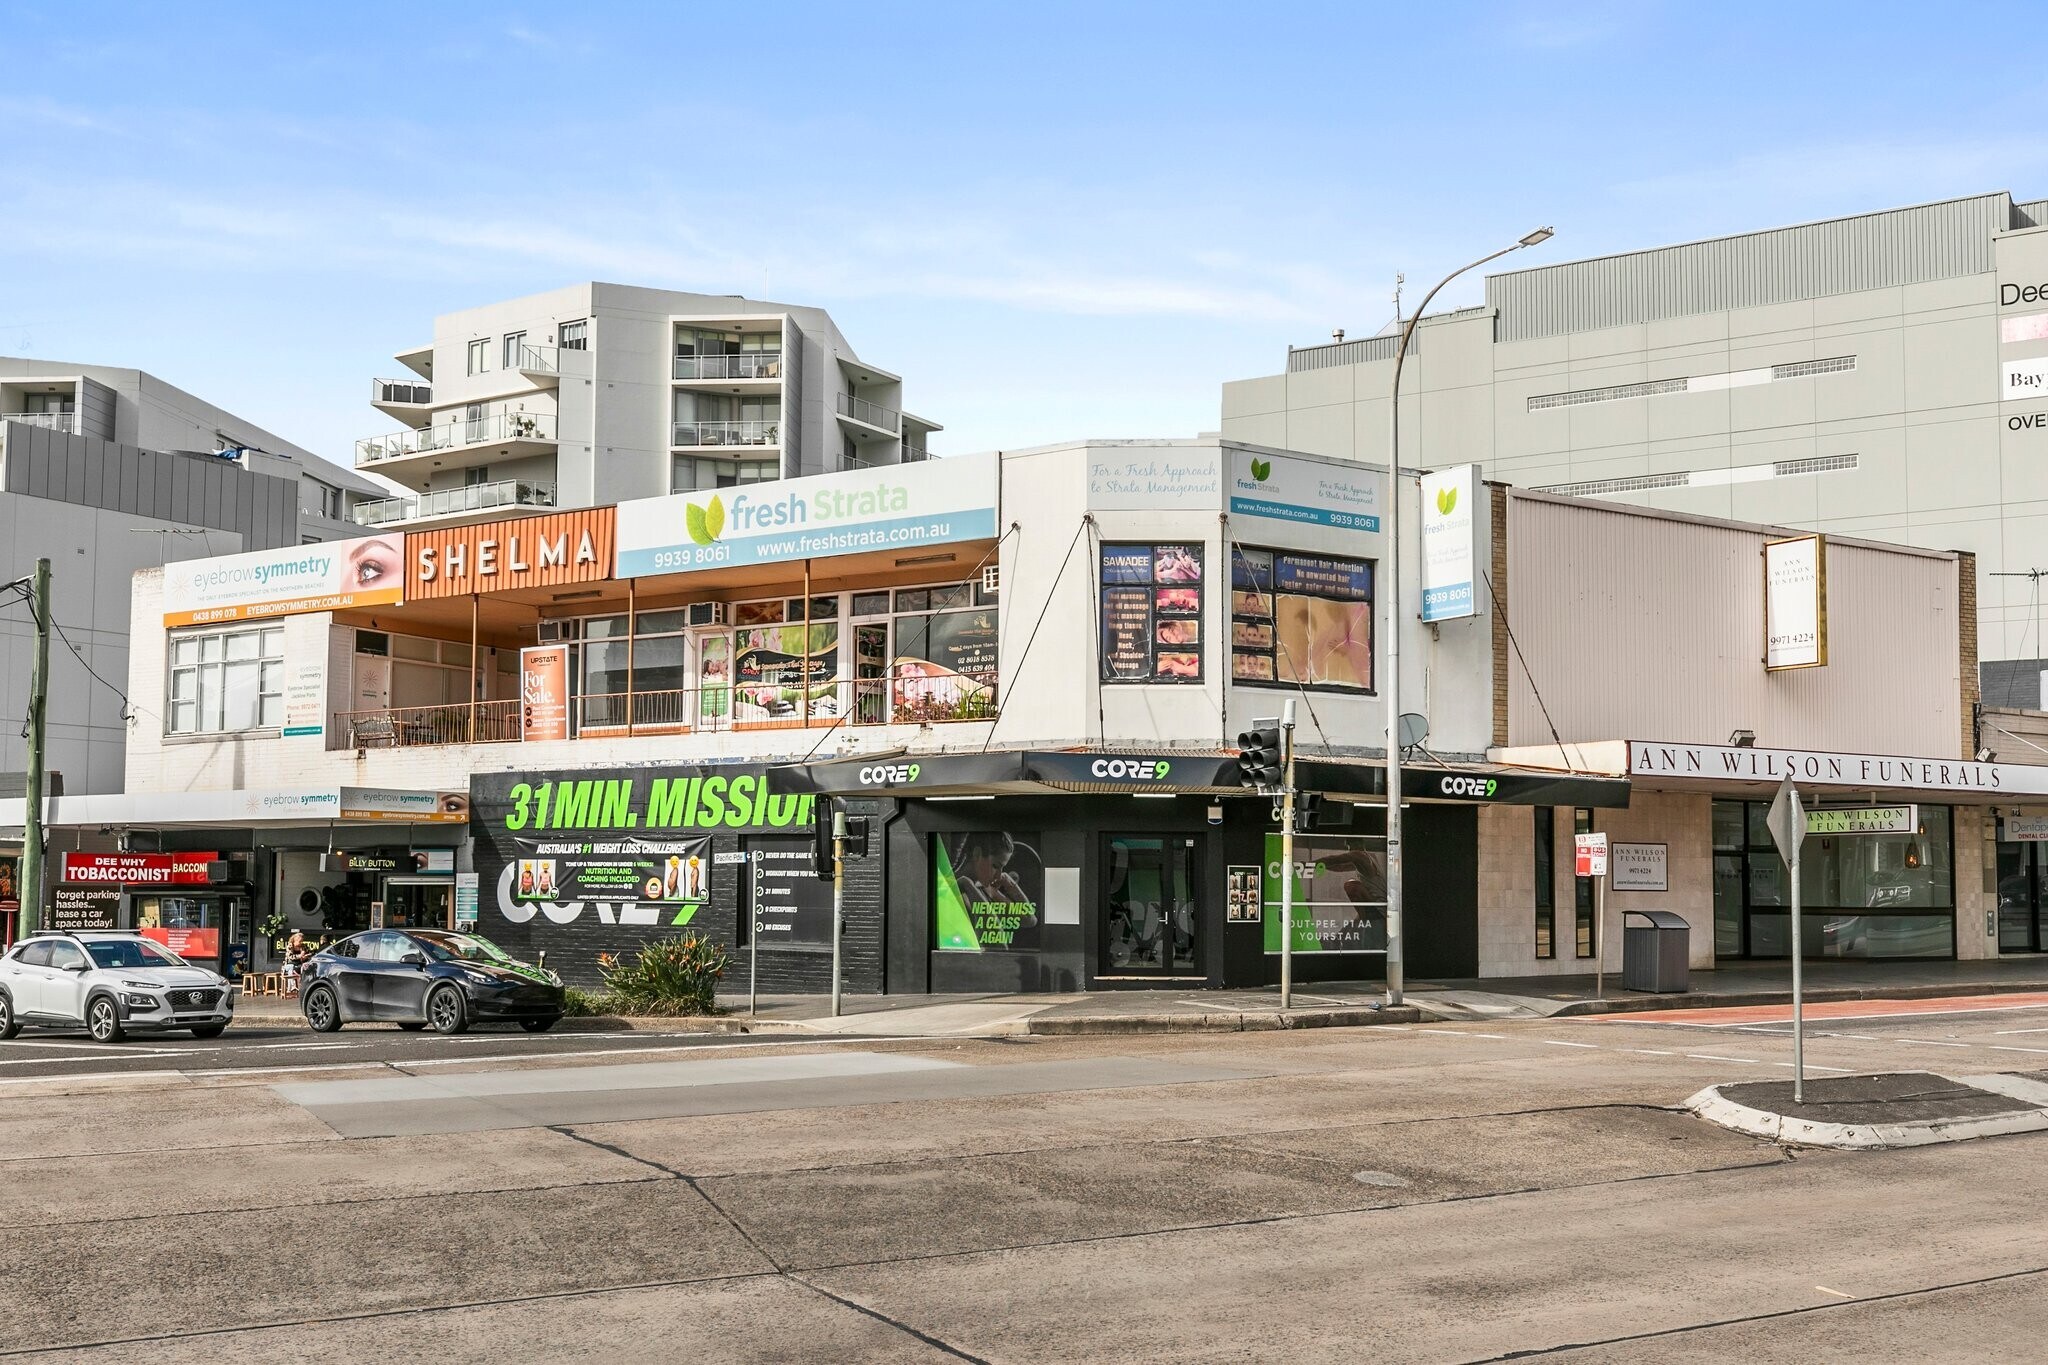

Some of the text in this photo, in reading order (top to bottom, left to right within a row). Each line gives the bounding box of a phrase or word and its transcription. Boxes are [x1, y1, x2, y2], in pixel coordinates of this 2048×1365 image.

[2001, 283, 2048, 306] Dee
[2008, 413, 2048, 430] OVE
[1092, 463, 1111, 477] For
[1126, 462, 1158, 476] Fresh
[1160, 461, 1217, 482] Approach
[1091, 479, 1217, 497] to Strata Management
[1237, 479, 1280, 493] fresh Strata
[731, 482, 909, 531] fresh Strata
[1237, 502, 1375, 528] www.freshstrata.com.au 9939 8061
[1424, 522, 1445, 535] fresh
[654, 521, 951, 568] 9939 8061 www.freshstrata.com.au
[418, 528, 597, 582] SHELMA
[1103, 556, 1149, 567] SAWADEE
[1283, 556, 1317, 568] Permanent
[1319, 560, 1332, 570] Hair
[1333, 562, 1364, 573] Reduction
[1296, 569, 1350, 583] No unwanted hair
[1425, 587, 1470, 604] 9939 8061
[193, 596, 354, 622] 0438 899 078 EYEBROWSYMMETRY.COM.AU
[1770, 633, 1814, 646] 9971 4224
[530, 655, 558, 664] UPSTATE
[524, 671, 546, 688] For
[859, 763, 921, 785] CORE9
[1091, 759, 1171, 780] CORE9
[1638, 747, 2000, 788] ANN WILSON FUNERALS
[1441, 776, 1497, 797] CORE9
[264, 793, 338, 808] eyebrow symmetry
[363, 792, 435, 805] eyebrow symmetry
[505, 782, 551, 830] 31
[552, 778, 637, 829] MIN.
[1807, 809, 1903, 821] ANN WILSON
[1817, 820, 1895, 831] FUNERALS
[536, 843, 686, 854] AUSTRALIA'S #1 WEIGHT LOSS CHALLENGE
[95, 857, 146, 866] DEE WHY
[368, 859, 395, 867] BUTTON
[716, 853, 743, 862] Pacific Pde
[1620, 855, 1661, 863] FUNERALS
[68, 866, 171, 882] TOBACCONIST
[1268, 861, 1326, 879] CRE9
[577, 875, 640, 883] COACHING INCLUDED
[56, 889, 120, 901] forget parking
[56, 900, 95, 909] hassles...
[972, 901, 1036, 915] NEVER MISS
[56, 909, 79, 918] lease
[89, 910, 103, 918] car
[55, 918, 113, 929] space today!
[976, 917, 1020, 930] A CLASS
[980, 931, 1014, 944] AGAIN
